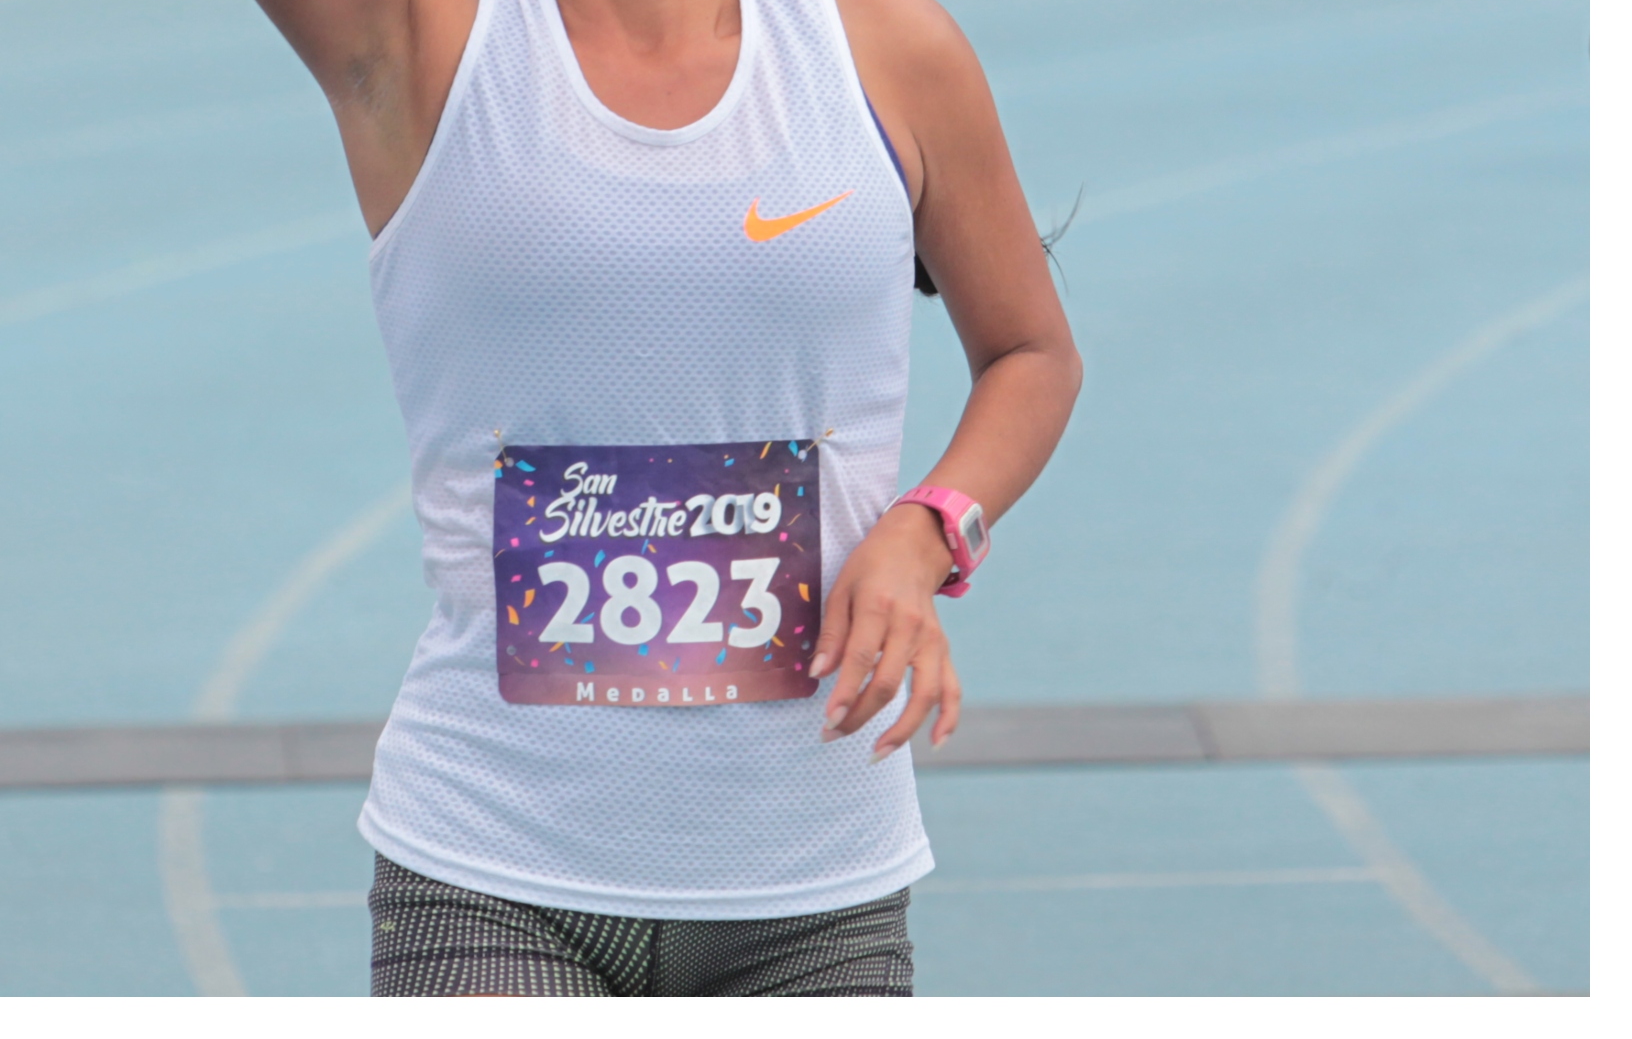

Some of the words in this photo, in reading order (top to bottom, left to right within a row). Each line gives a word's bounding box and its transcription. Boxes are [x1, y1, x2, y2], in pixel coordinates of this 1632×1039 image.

[560, 461, 618, 497] San
[539, 494, 687, 543] Silvestre
[684, 492, 782, 537] 2019
[537, 555, 782, 648] 2823
